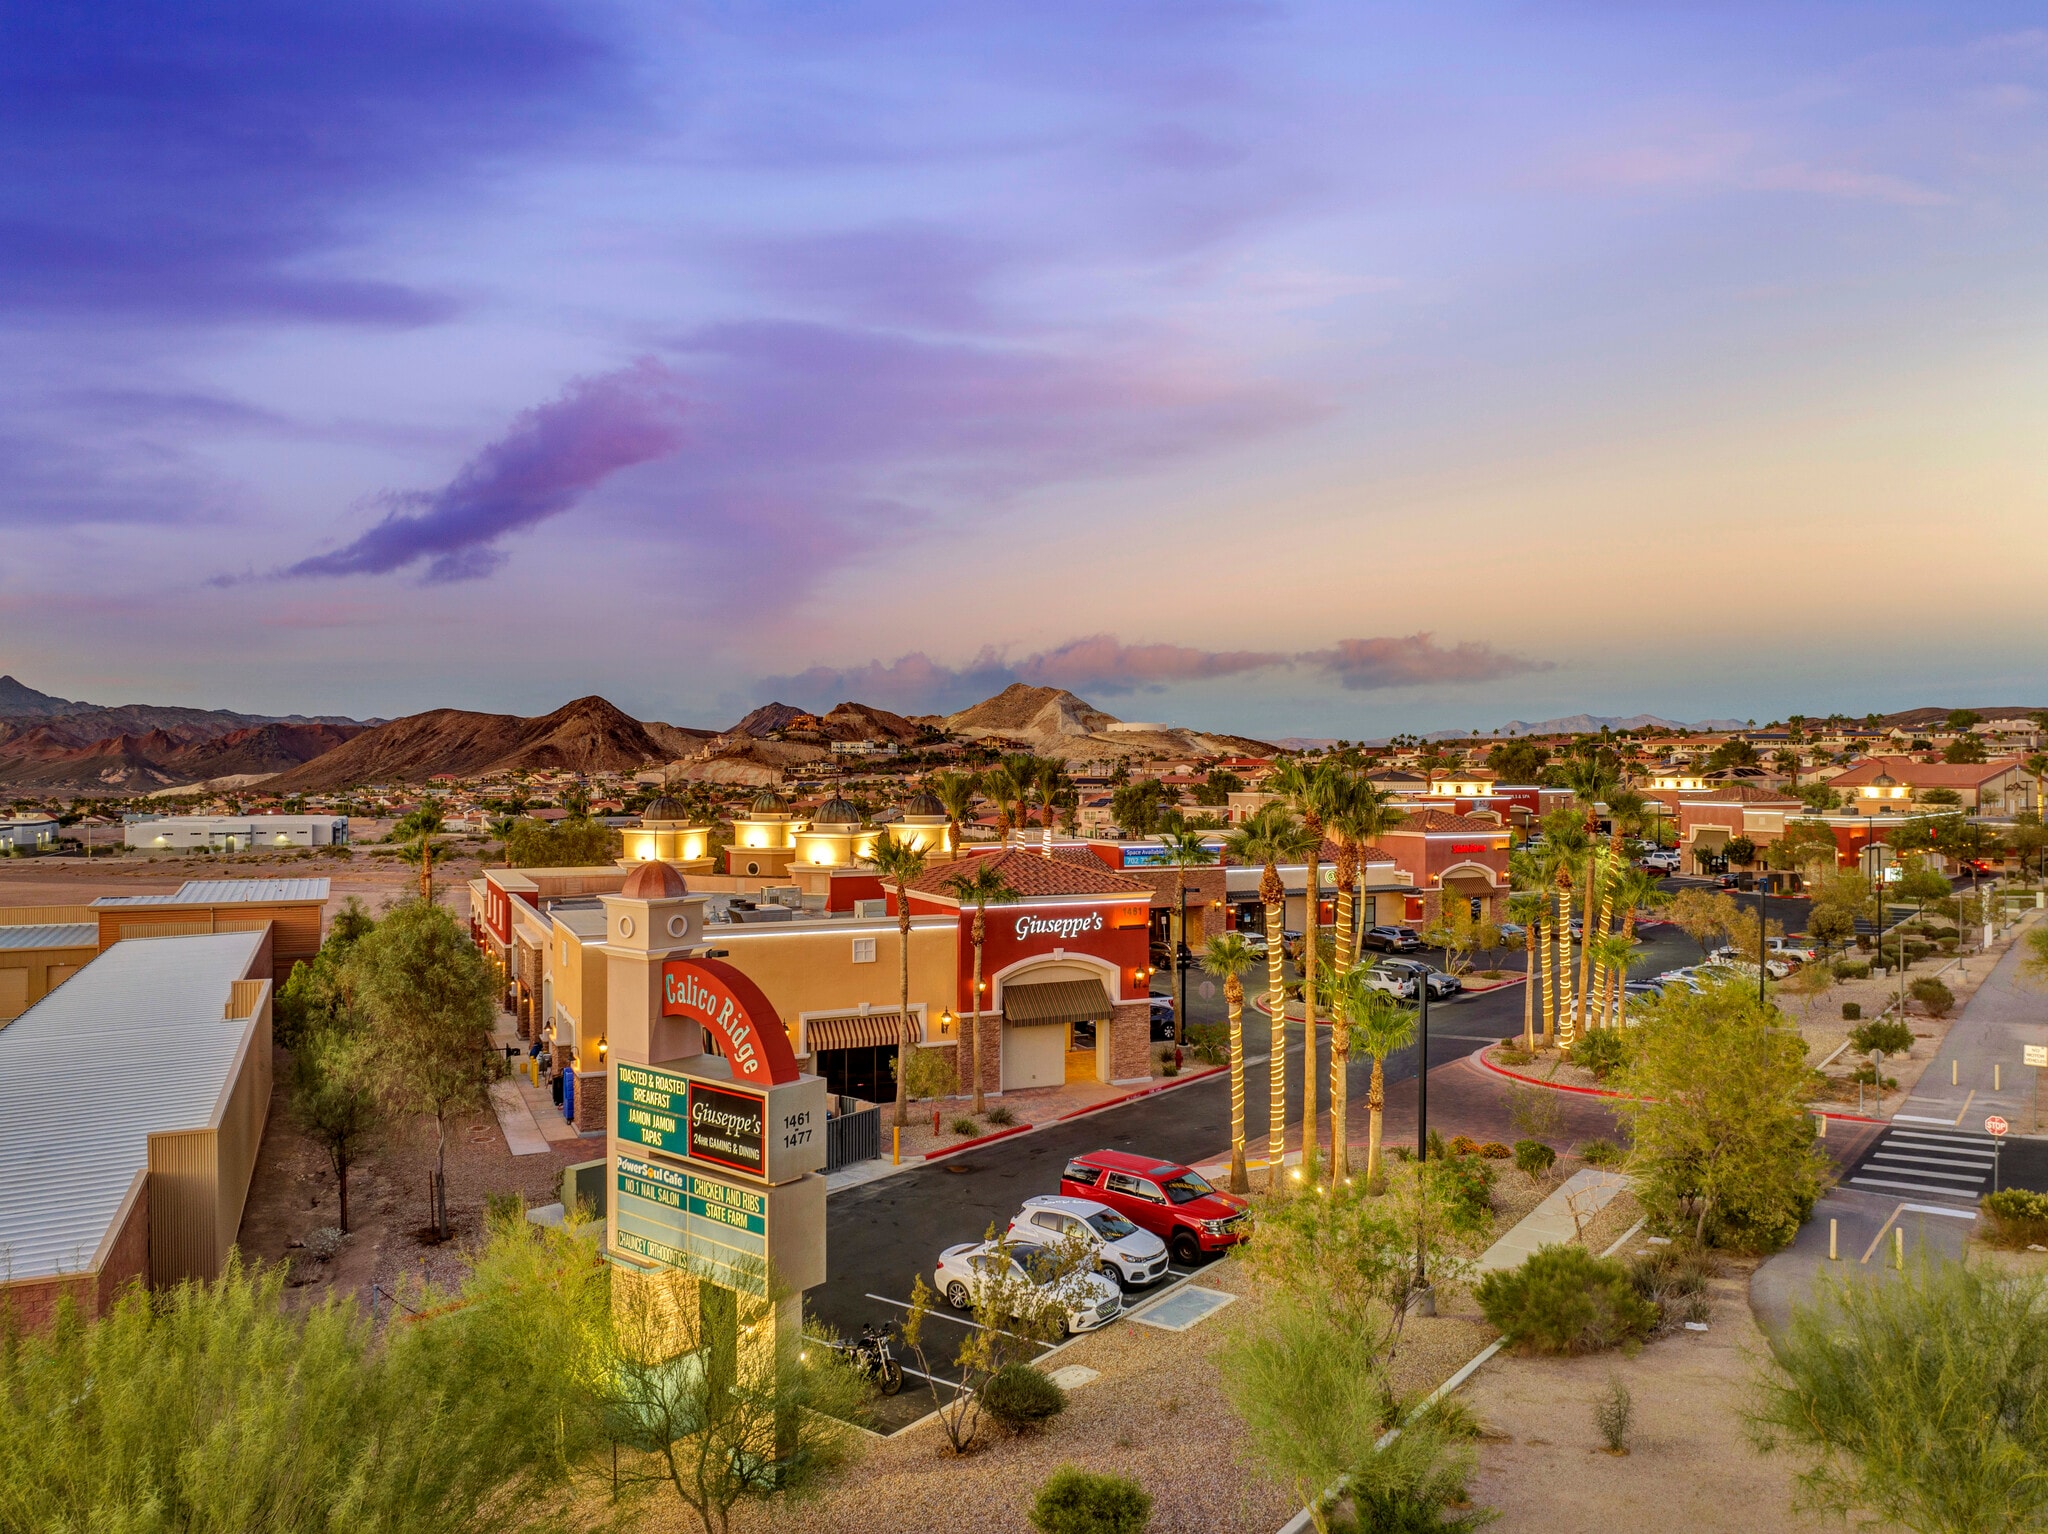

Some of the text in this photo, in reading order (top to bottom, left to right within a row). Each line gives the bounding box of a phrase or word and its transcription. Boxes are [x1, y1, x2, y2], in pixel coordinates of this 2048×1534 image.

[1016, 912, 1103, 941] Giuseppe's
[665, 973, 759, 1074] Calico Ridge
[619, 1067, 686, 1096] TOASTED & ROASTED
[633, 1087, 671, 1109] BREAKFAST
[628, 1108, 675, 1133] JAMON JAMON
[692, 1102, 762, 1138] Giuseppe's
[784, 1111, 810, 1129] 1461
[1987, 1121, 2006, 1130] STOP
[641, 1128, 662, 1146] TAPAS
[709, 1137, 732, 1153] GAMING
[732, 1143, 738, 1154] &
[739, 1145, 760, 1161] DINING
[784, 1129, 812, 1148] 1477
[663, 1171, 683, 1187] Cafe
[625, 1178, 680, 1207] NO.1 NAIL SALON
[693, 1179, 760, 1213] CHICKEN AND RIBS
[705, 1202, 748, 1229] STATE FARM
[618, 1231, 688, 1269] CHAUNCEY ORTHODONTICS
